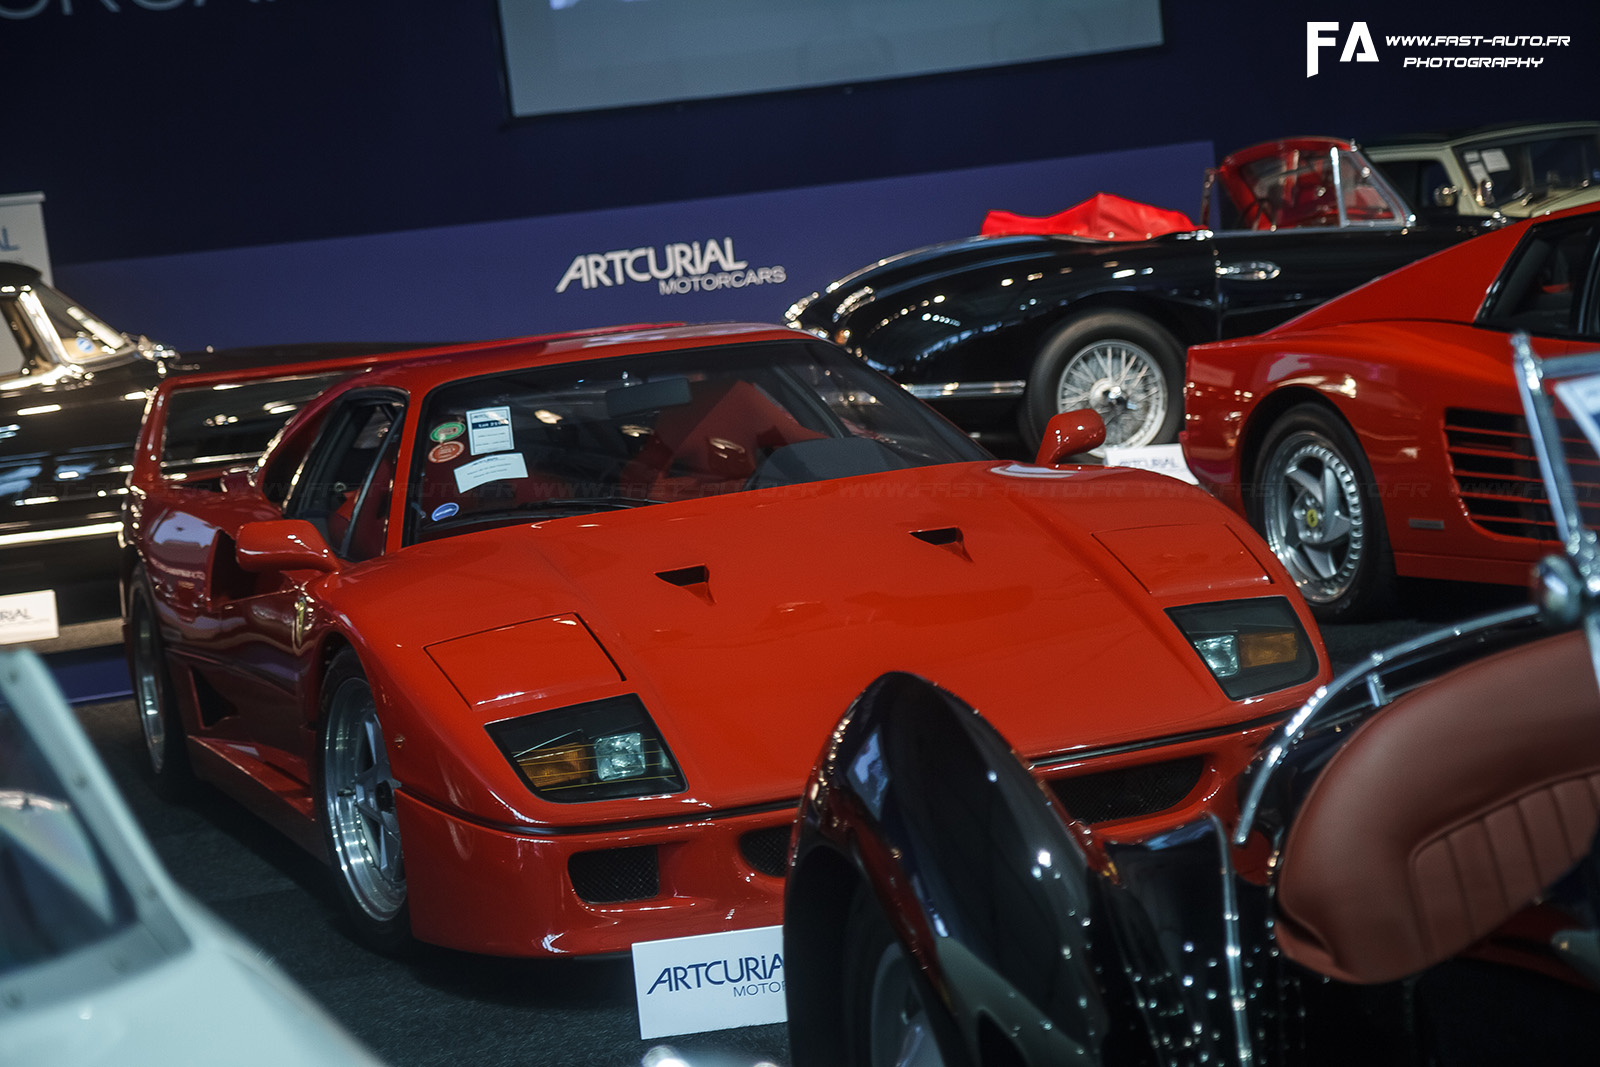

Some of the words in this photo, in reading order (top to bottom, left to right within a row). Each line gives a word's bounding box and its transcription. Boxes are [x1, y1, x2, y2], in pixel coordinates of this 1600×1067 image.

[658, 266, 787, 295] MOTORCARS
[646, 953, 784, 995] ARTCURIA
[733, 980, 785, 997] MOTO
